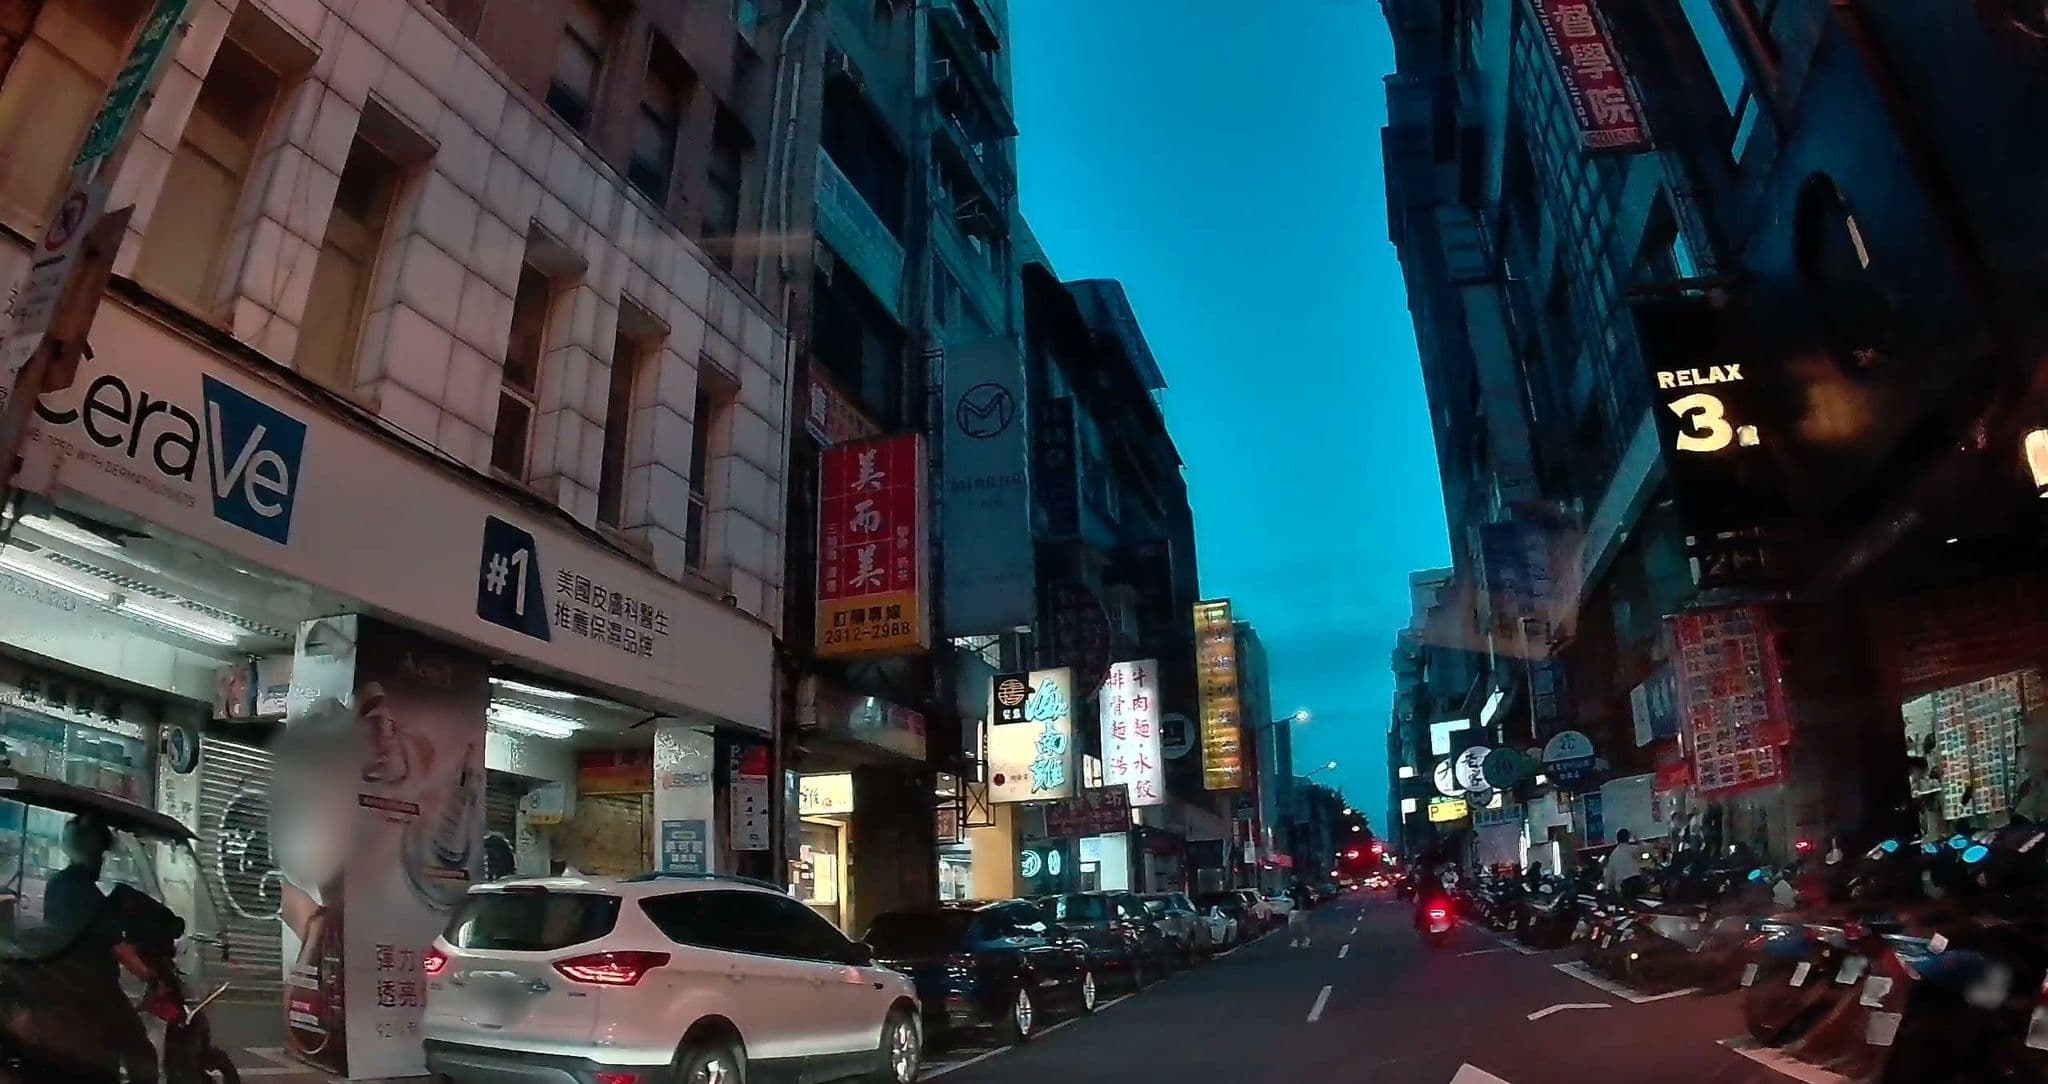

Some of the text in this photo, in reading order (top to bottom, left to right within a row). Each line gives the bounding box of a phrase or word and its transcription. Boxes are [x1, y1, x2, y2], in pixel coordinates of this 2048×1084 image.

[1657, 364, 1744, 389] RELAX
[850, 449, 886, 588] 美而美
[486, 547, 529, 617] #1
[557, 568, 669, 636] 美國皮膚科醫生
